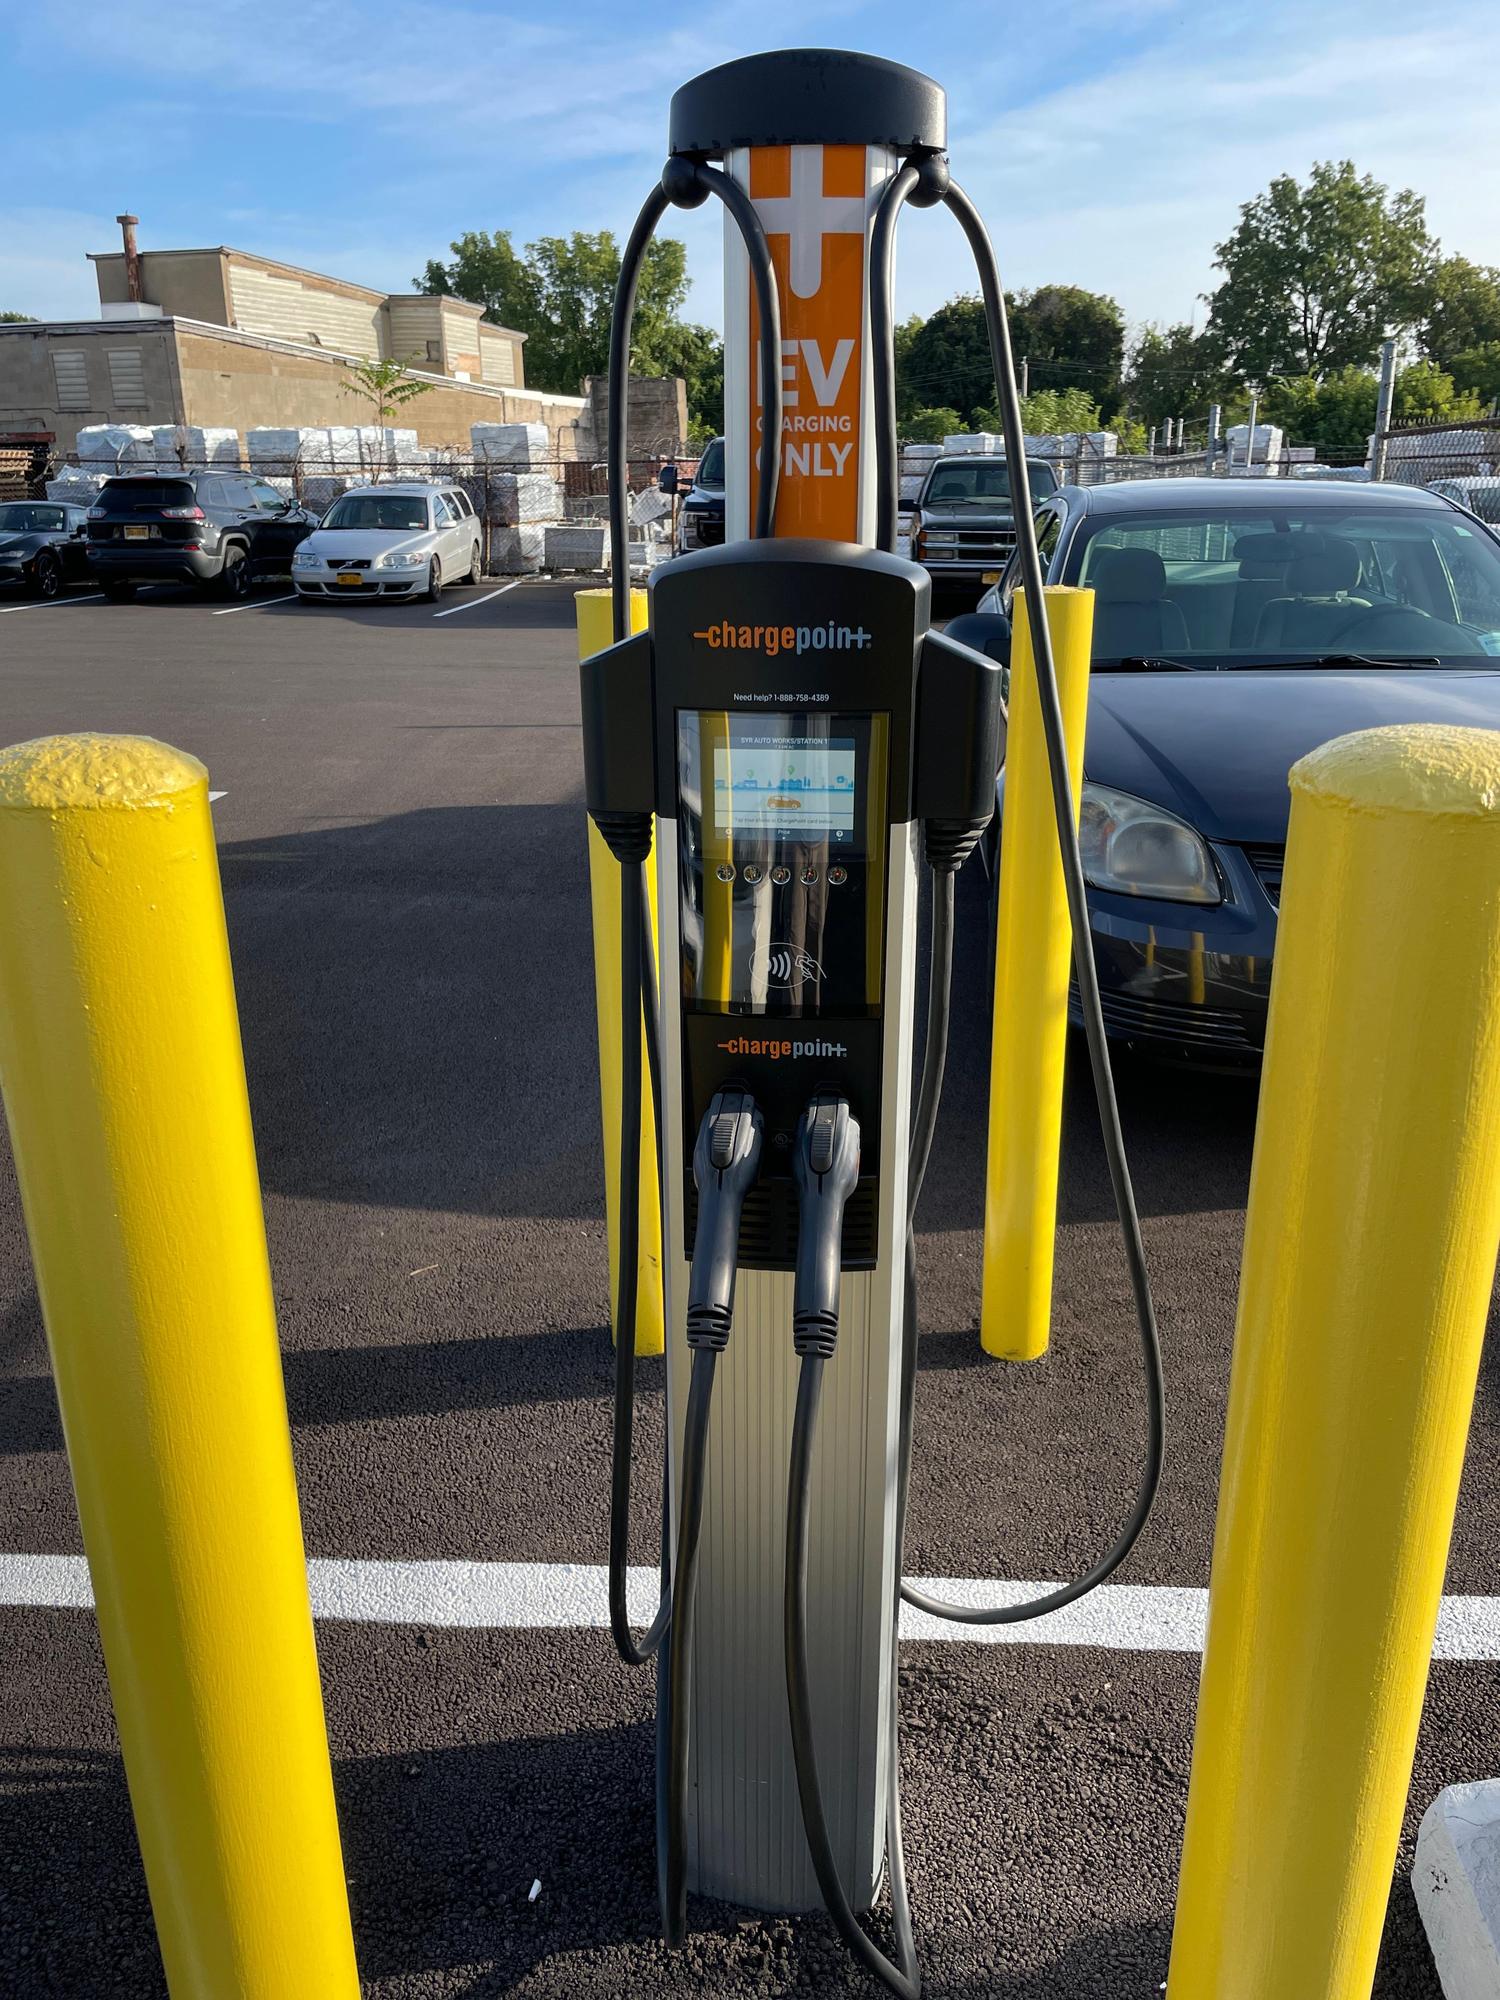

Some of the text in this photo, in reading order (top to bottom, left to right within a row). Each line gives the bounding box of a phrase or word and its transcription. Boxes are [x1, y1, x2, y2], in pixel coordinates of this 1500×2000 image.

[756, 416, 851, 432] ARGING
[756, 442, 853, 476] NLY
[734, 693, 830, 703] Need help? 1-888-758-4389
[754, 737, 771, 745] AUTO
